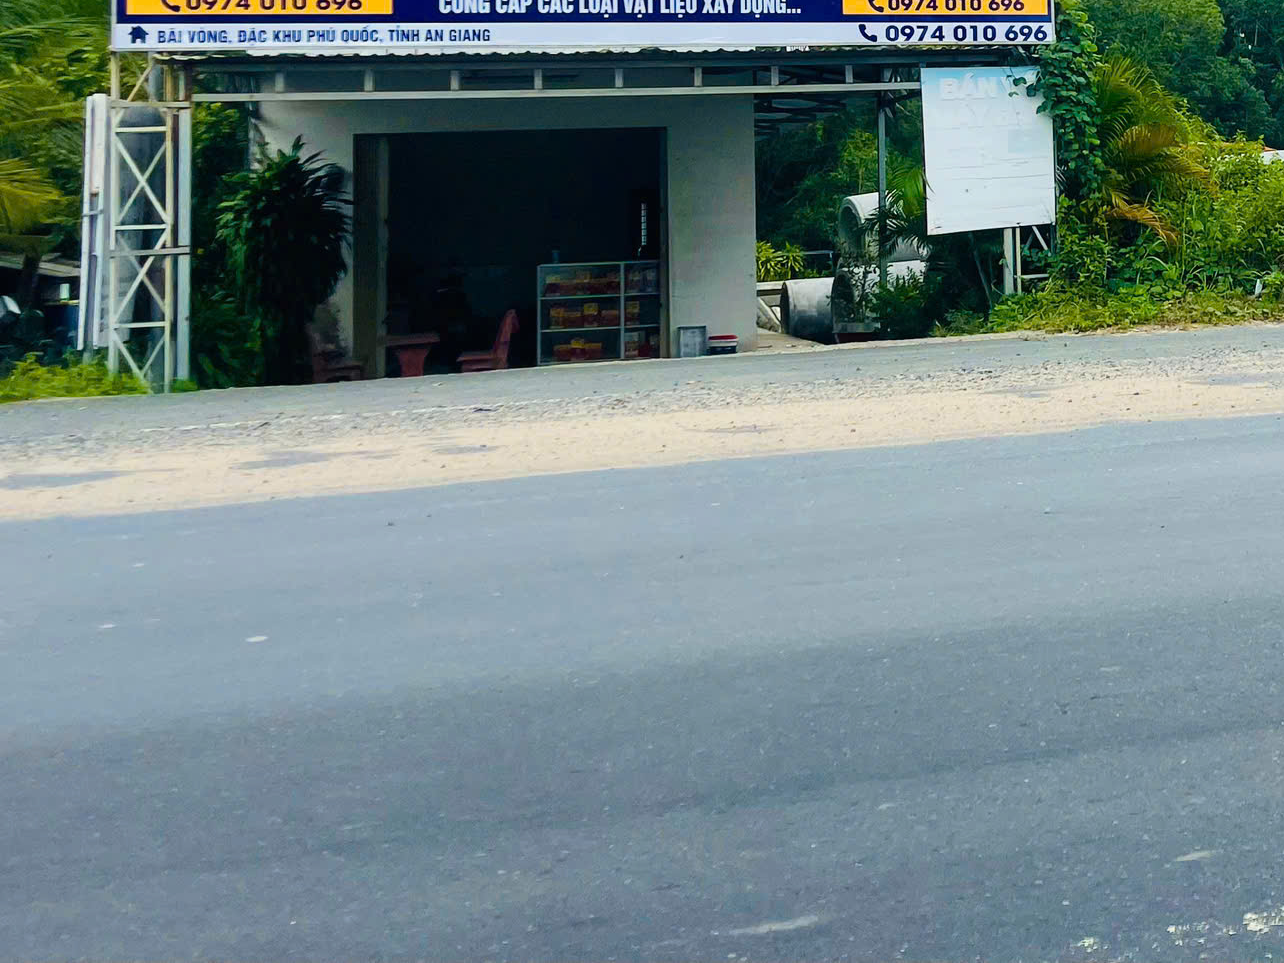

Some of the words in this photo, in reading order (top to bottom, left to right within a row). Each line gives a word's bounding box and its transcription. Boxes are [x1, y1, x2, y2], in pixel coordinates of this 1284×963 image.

[272, 29, 302, 43] KHU
[306, 27, 336, 42] PHÚ
[340, 25, 383, 43] QUỐC,
[424, 29, 444, 42] AN
[448, 29, 491, 42] GIANG
[885, 25, 947, 43] 0974
[954, 25, 1000, 42] 010
[1005, 25, 1048, 42] 696
